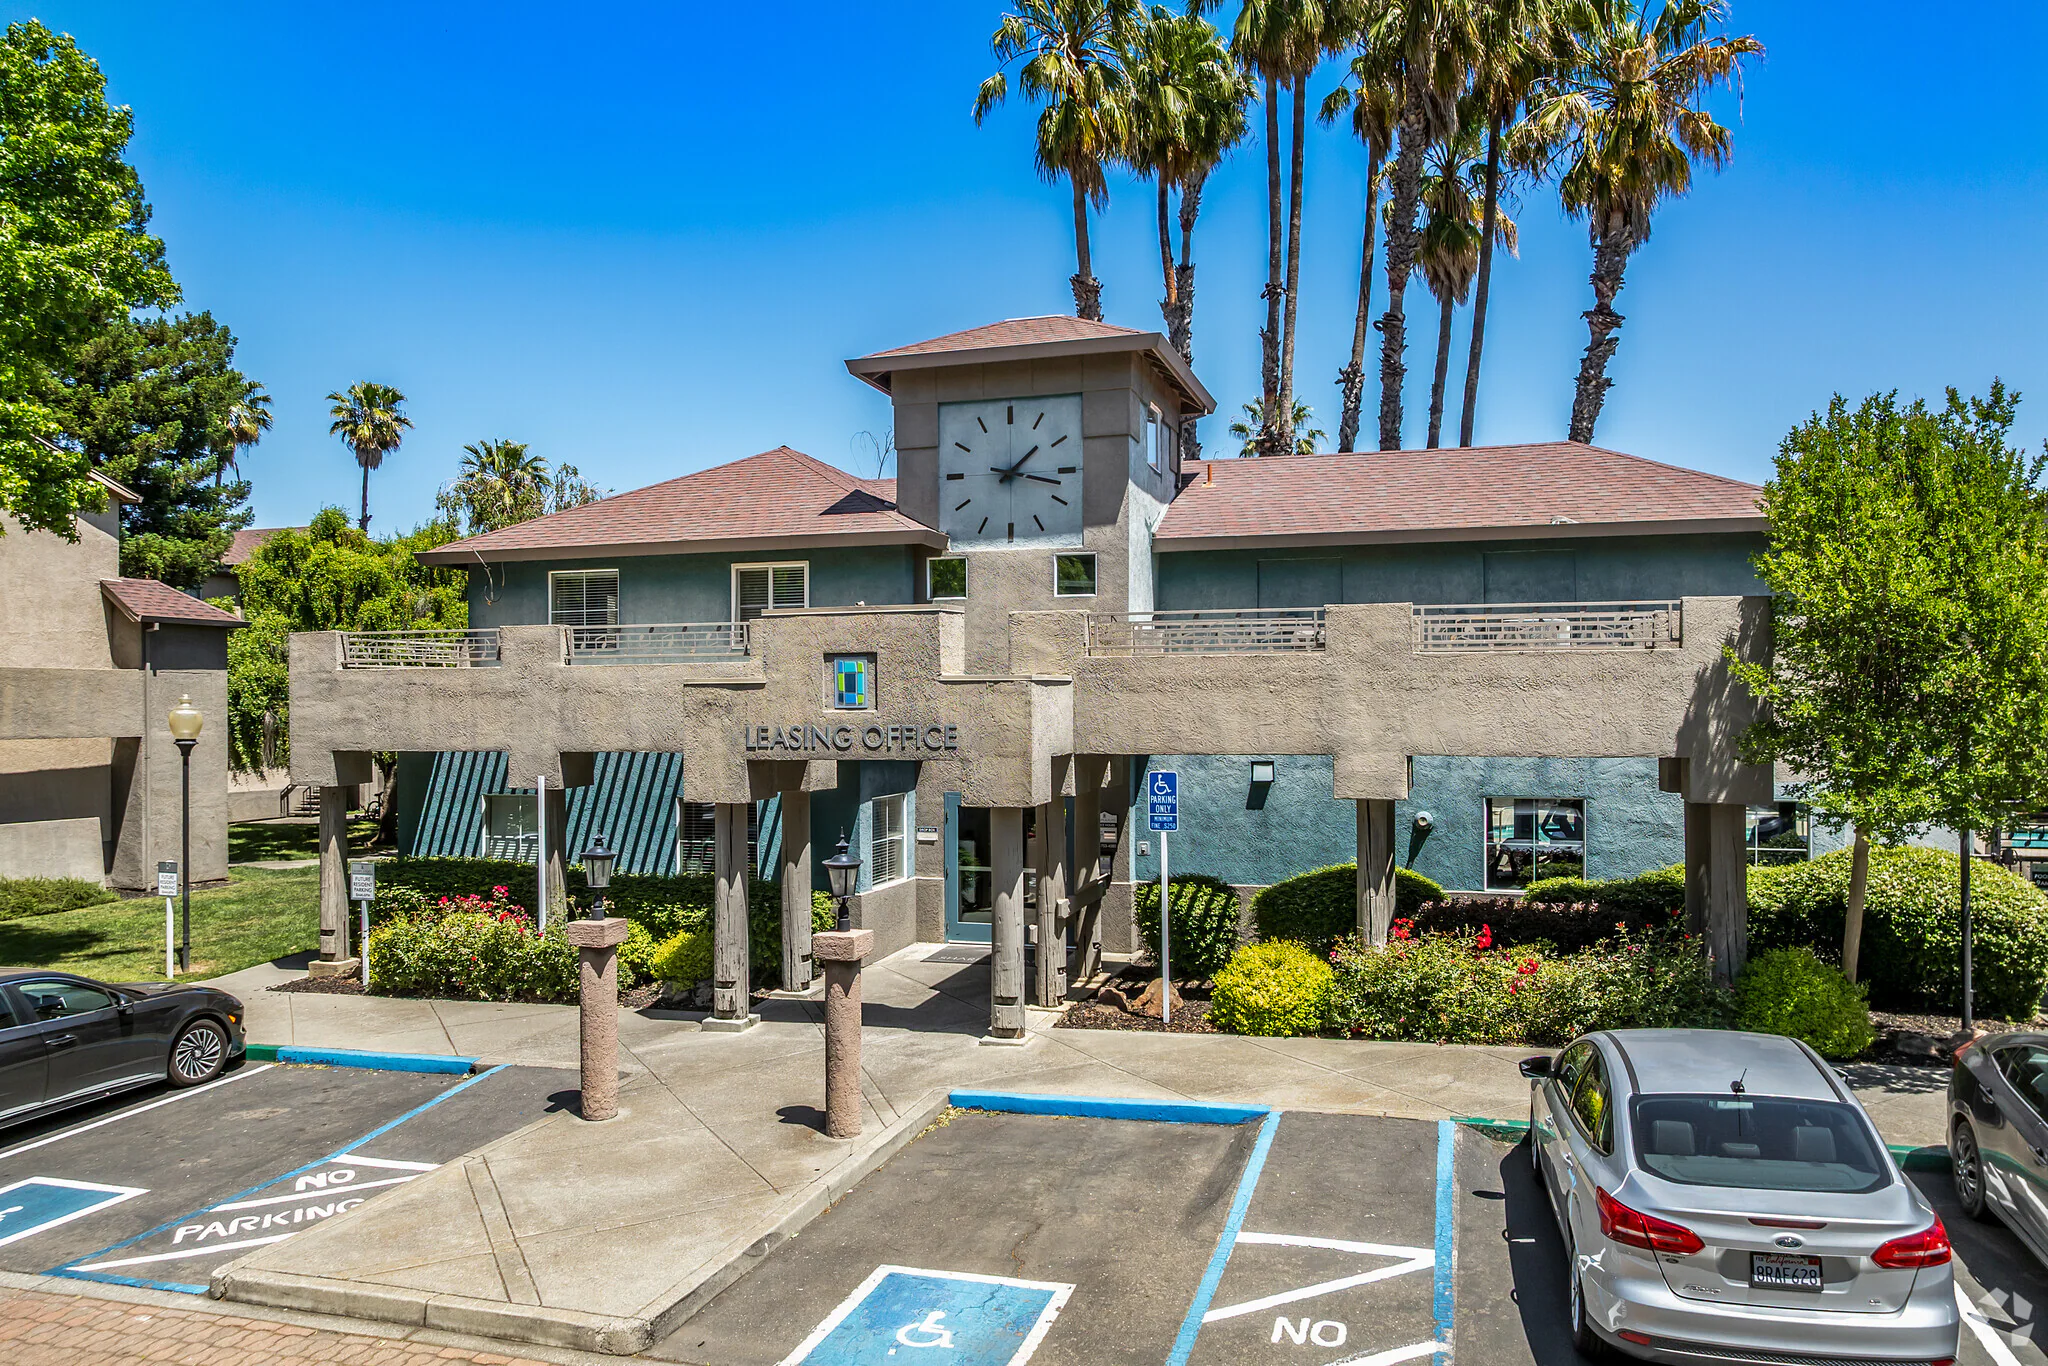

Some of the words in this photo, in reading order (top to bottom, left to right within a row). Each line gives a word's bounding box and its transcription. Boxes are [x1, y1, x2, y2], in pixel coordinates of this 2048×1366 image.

[745, 724, 852, 750] LEASING
[862, 724, 957, 750] OFFICE
[1150, 795, 1176, 804] PARKING
[1155, 804, 1172, 813] ONLY
[294, 1169, 356, 1192] NO
[1765, 1255, 1805, 1266] California
[1756, 1265, 1818, 1286] 8RAF628
[1270, 1316, 1348, 1348] NO
